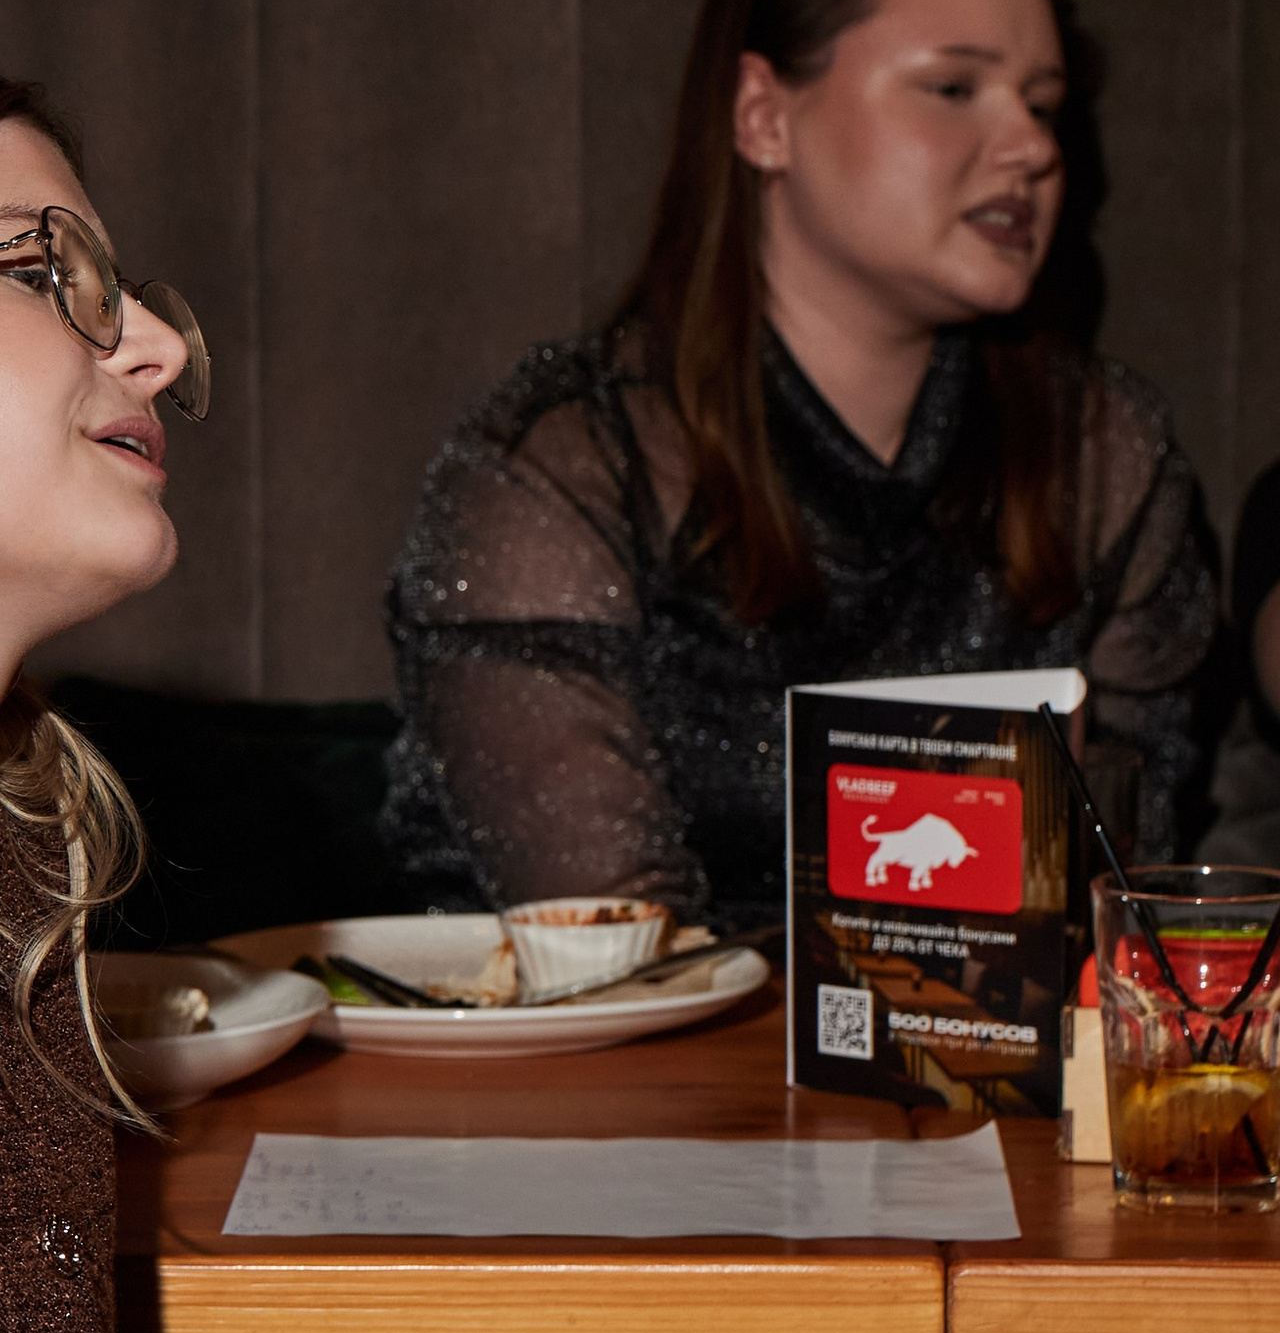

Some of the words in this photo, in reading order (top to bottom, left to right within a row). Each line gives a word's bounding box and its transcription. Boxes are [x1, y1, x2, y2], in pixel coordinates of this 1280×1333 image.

[877, 734, 908, 753] КАРТА
[954, 741, 1017, 762] СМАРТФОНЕ
[872, 933, 891, 952] ДО
[917, 939, 934, 956] ОТ
[935, 941, 970, 959] ЧЕКА
[957, 925, 1017, 946] бонусами
[888, 1011, 932, 1033] 500
[933, 1016, 1038, 1043] БОНУСОВ
